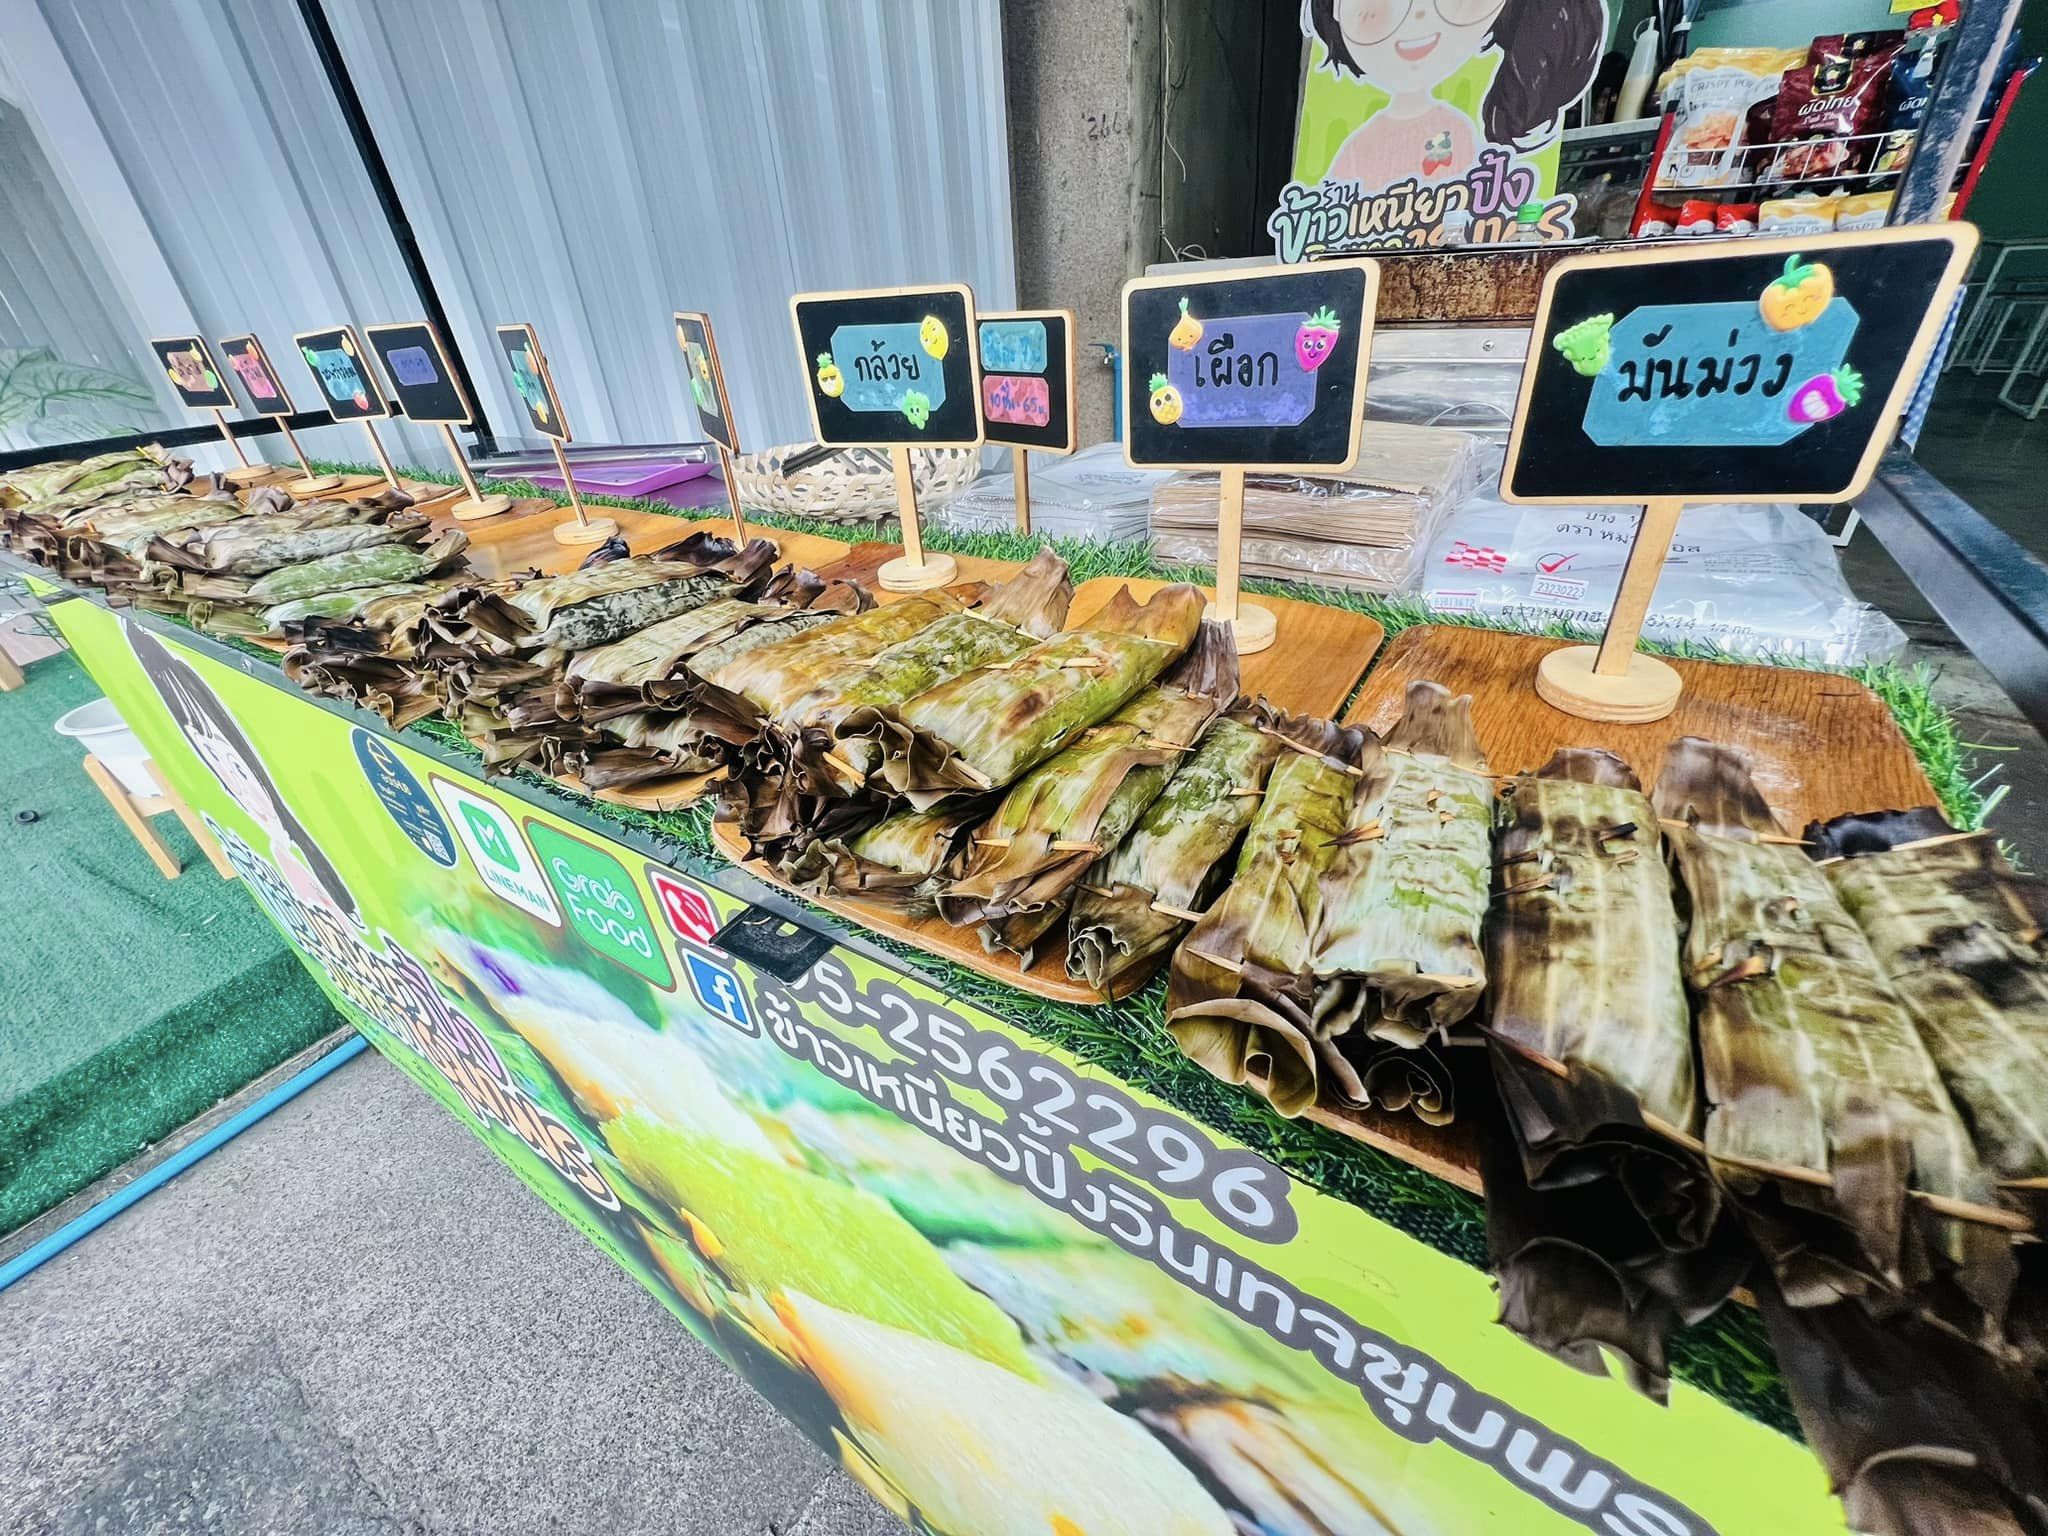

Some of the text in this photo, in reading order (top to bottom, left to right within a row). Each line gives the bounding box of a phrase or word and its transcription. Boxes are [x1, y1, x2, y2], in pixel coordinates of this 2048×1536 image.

[1273, 152, 1532, 264] ข้าวเหนียวปิ้ง
[1322, 180, 1360, 207] ร้าน
[853, 339, 921, 383] กล้วย
[1193, 332, 1279, 390] เผือก
[1617, 324, 1795, 403] มันม่วง
[1536, 580, 1587, 599] 23230223
[551, 856, 636, 921] Grab
[565, 891, 653, 959] Food
[792, 959, 1276, 1227] 5-2562296
